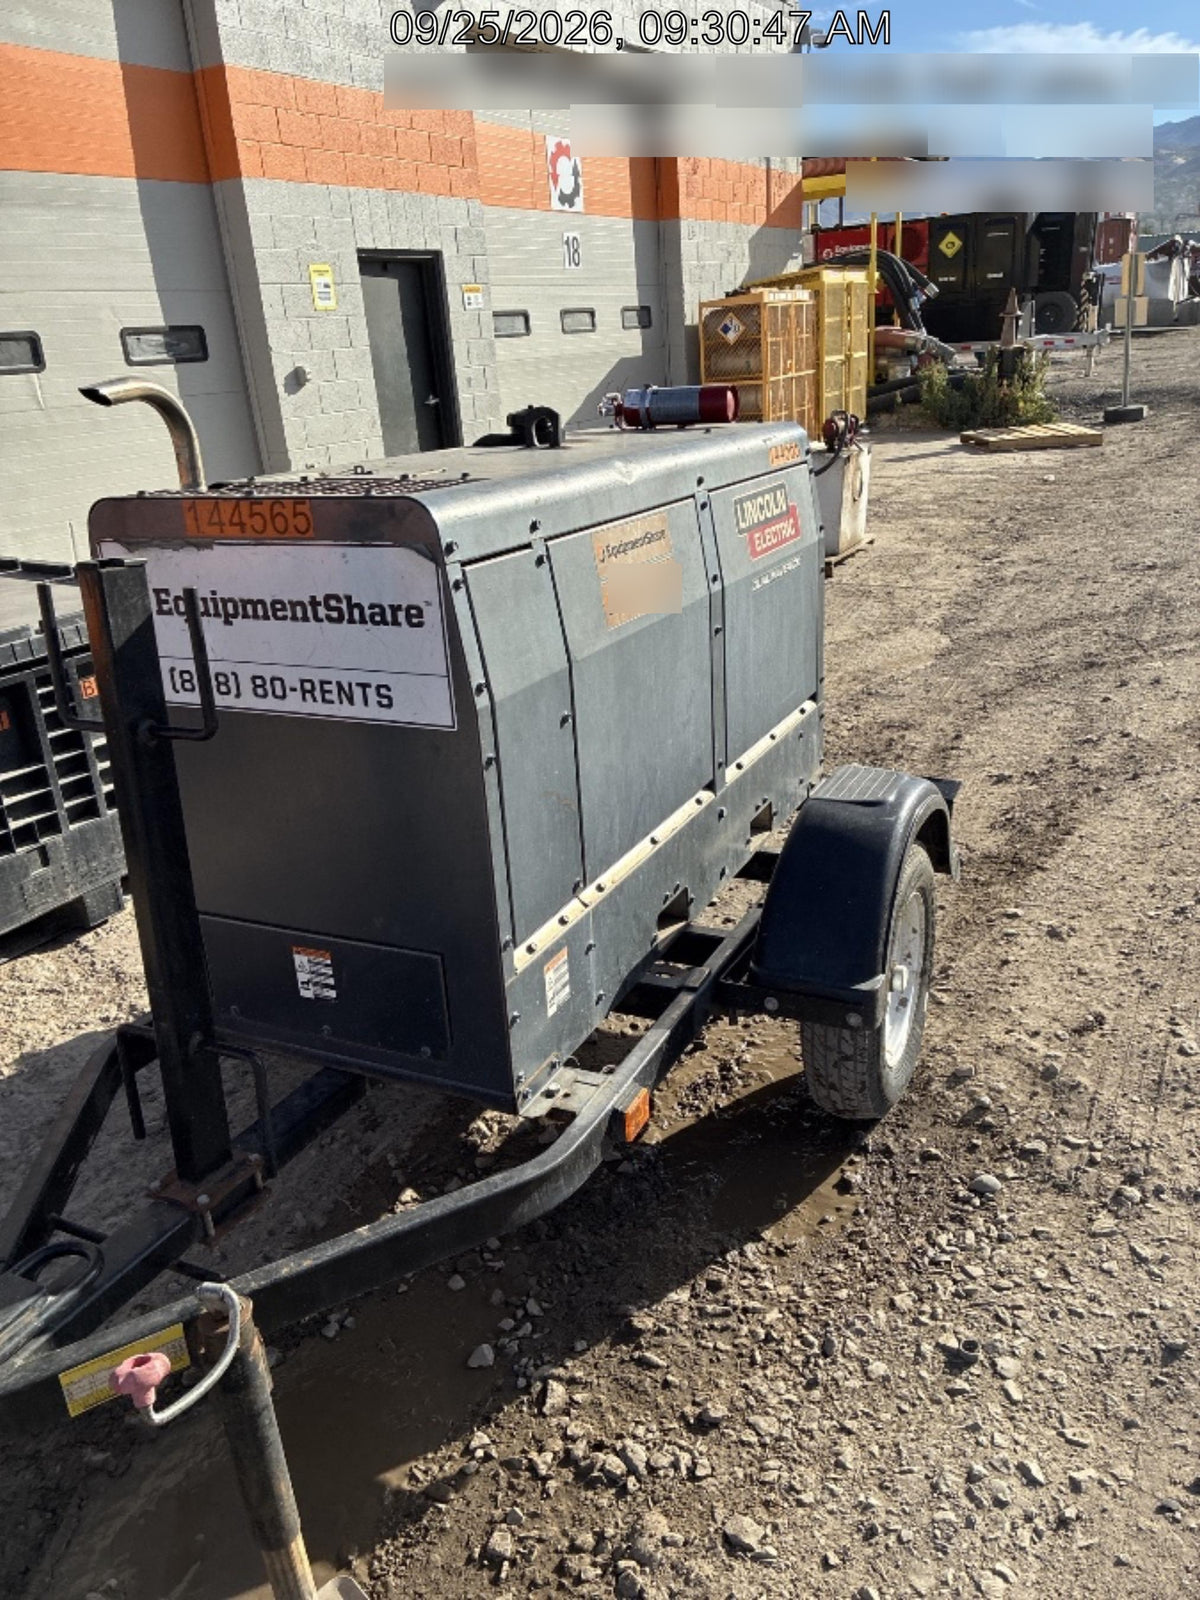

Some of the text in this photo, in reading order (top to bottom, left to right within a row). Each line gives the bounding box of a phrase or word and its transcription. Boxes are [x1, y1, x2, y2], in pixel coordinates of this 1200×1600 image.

[564, 235, 580, 267] 18
[187, 499, 312, 535] 144565
[736, 488, 788, 529] LINCOLN
[754, 517, 796, 552] ELECTRIC
[169, 666, 394, 710] (88) 80-RENTS
